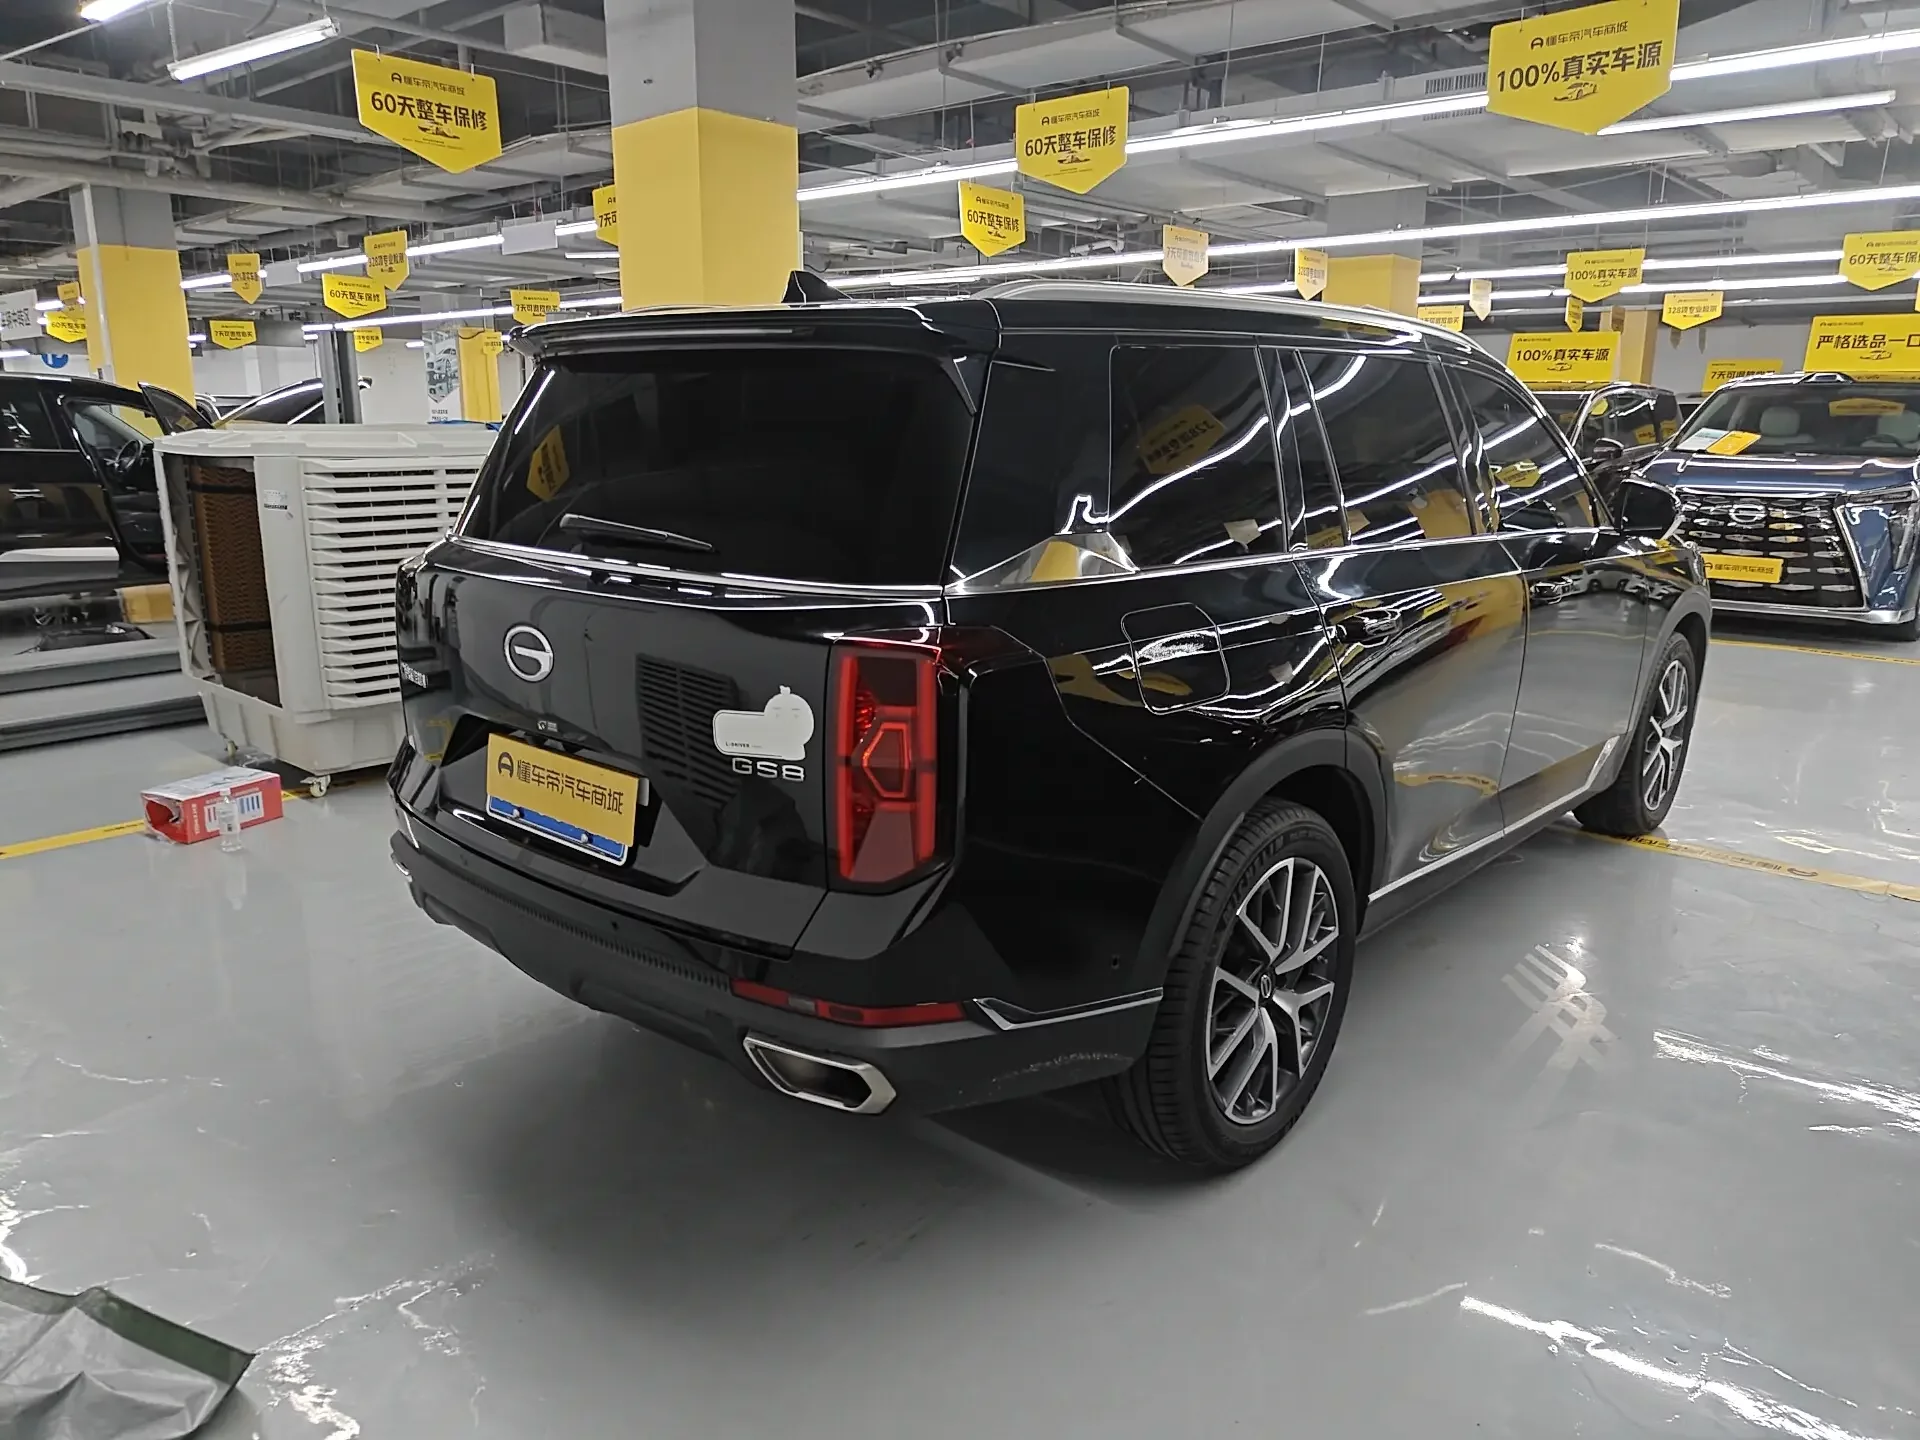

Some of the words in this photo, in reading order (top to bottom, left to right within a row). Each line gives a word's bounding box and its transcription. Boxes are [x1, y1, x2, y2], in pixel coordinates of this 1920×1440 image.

[1545, 21, 1628, 47] 懂车帝汽车商城
[1497, 40, 1662, 92] 100%真实车源
[371, 91, 488, 131] 60天整车保修
[1025, 125, 1116, 156] 60天整车保修
[967, 209, 1020, 232] 60天整车保修
[1570, 267, 1638, 281] 100%真实车源
[329, 290, 380, 303] 60天整车保修
[1516, 348, 1610, 362] 100%真实车源
[732, 757, 805, 782] GS8
[517, 759, 624, 815] 懂车帝汽车商城
